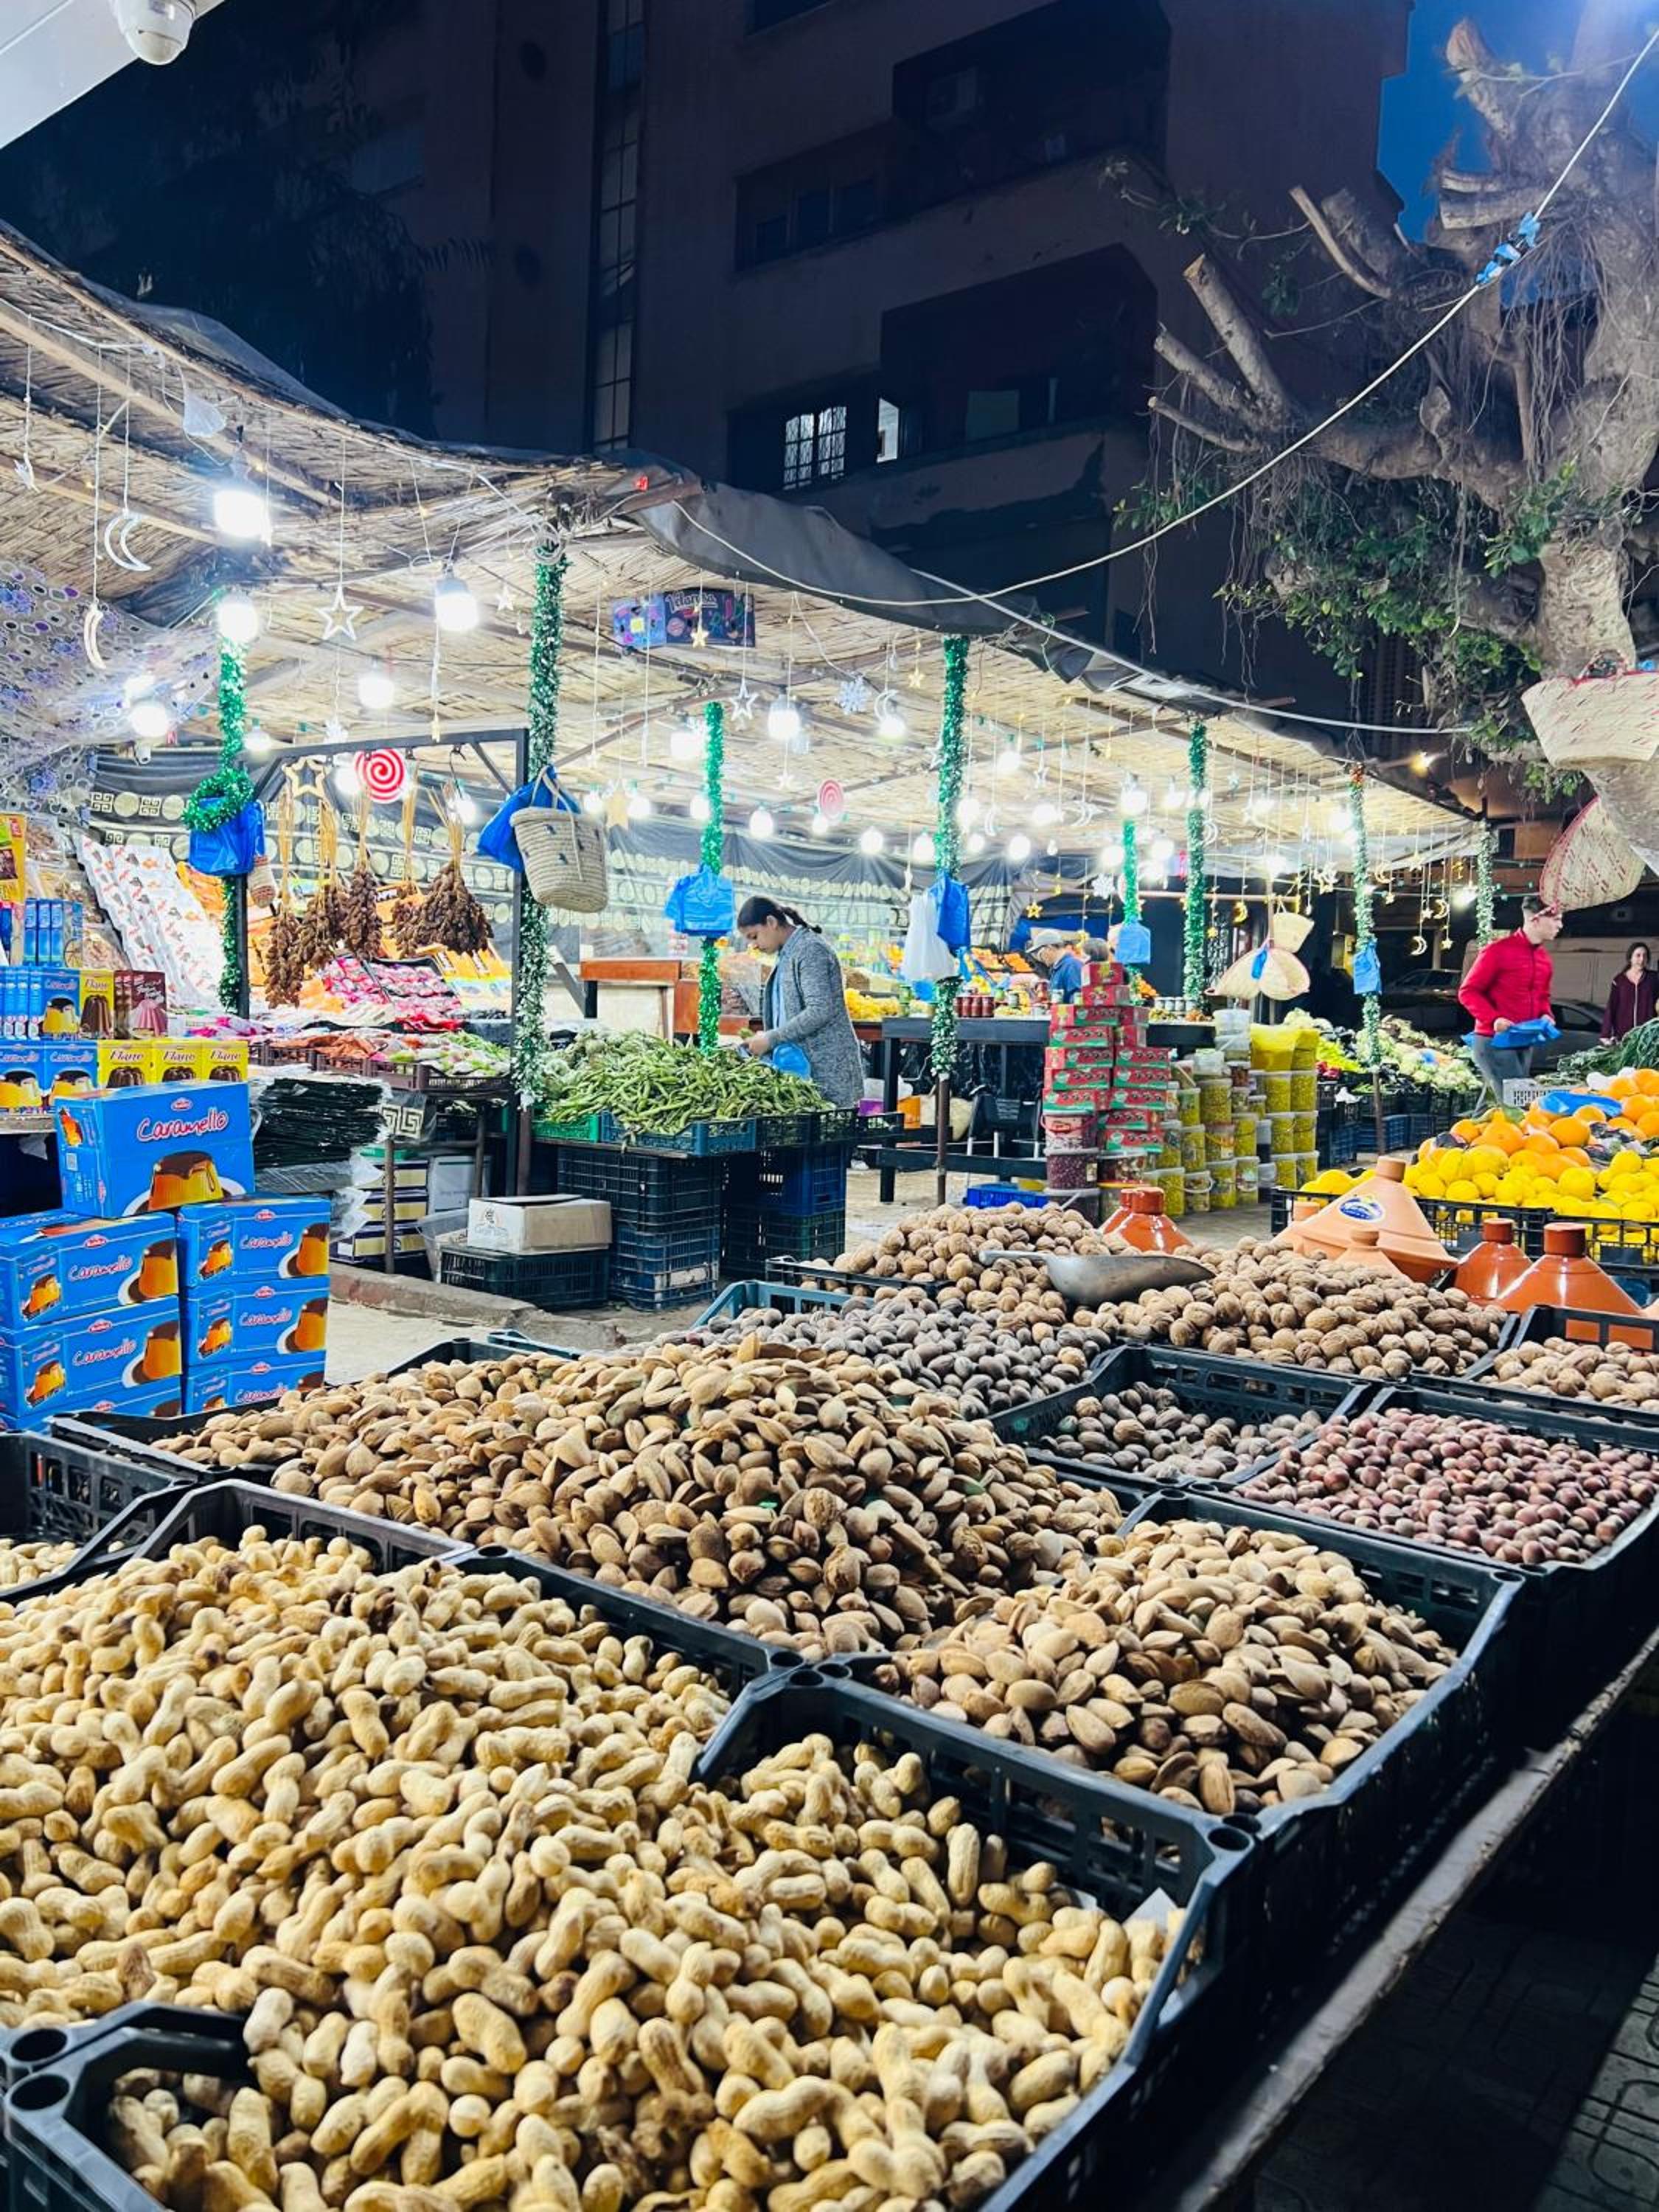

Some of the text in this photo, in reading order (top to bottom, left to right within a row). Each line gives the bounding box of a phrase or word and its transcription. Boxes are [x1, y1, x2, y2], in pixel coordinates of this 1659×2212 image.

[137, 1107, 229, 1141] Caramello
[240, 1231, 293, 1249] Caramello
[68, 1255, 133, 1281] Caramello
[239, 1307, 292, 1326] Caramello
[72, 1338, 136, 1366] Caramello
